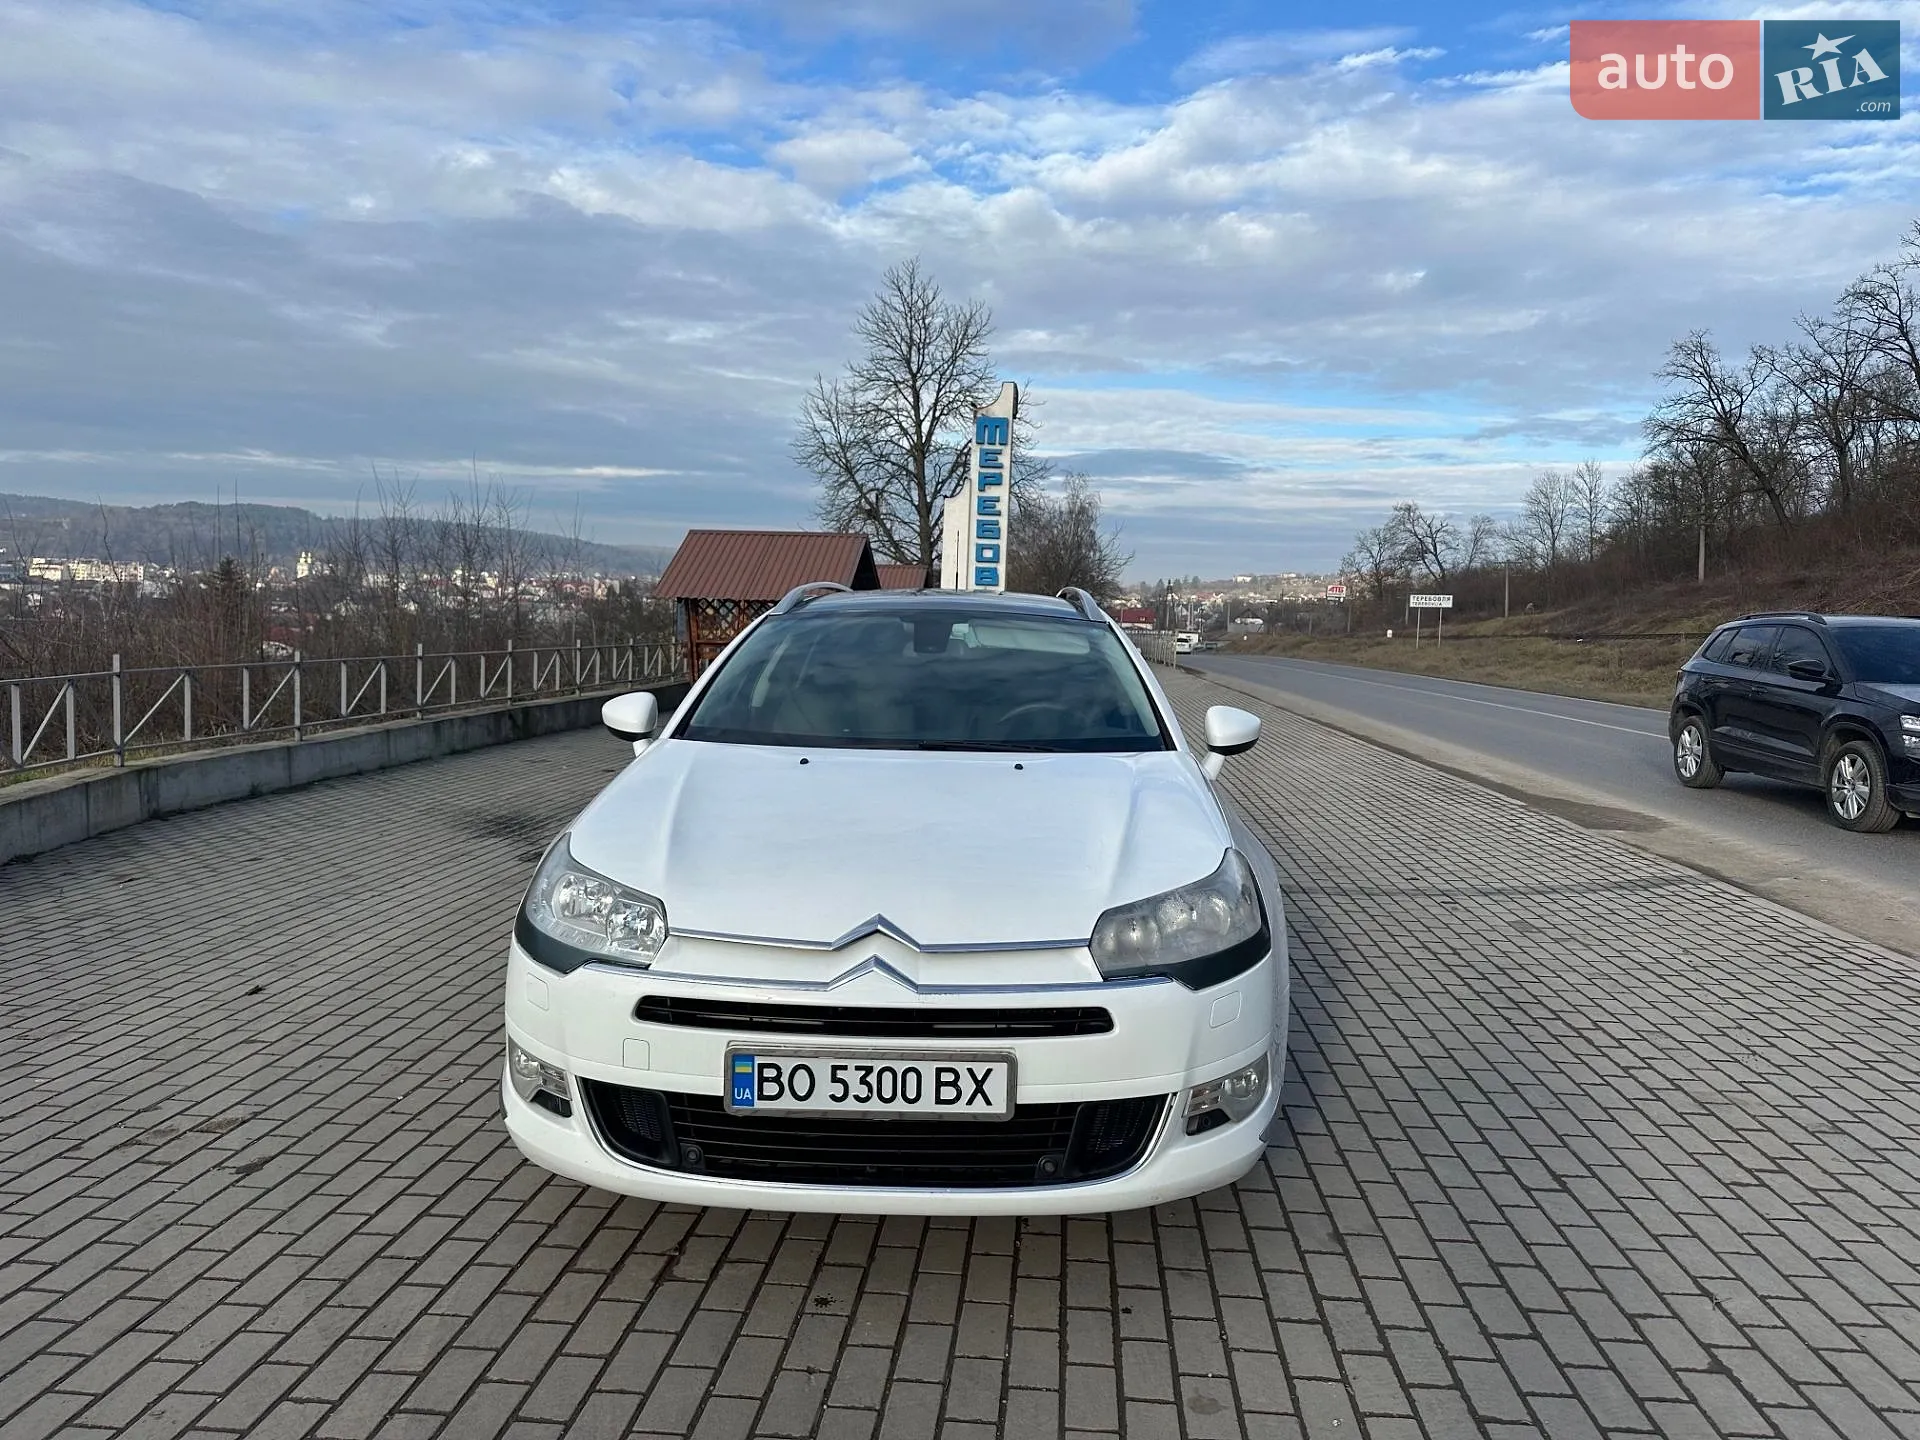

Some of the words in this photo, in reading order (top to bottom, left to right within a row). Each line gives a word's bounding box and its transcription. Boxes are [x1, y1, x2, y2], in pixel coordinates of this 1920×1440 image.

[735, 1087, 752, 1100] UA
[757, 1062, 816, 1102] BO
[828, 1064, 922, 1104] 5300
[934, 1066, 994, 1106] BX
